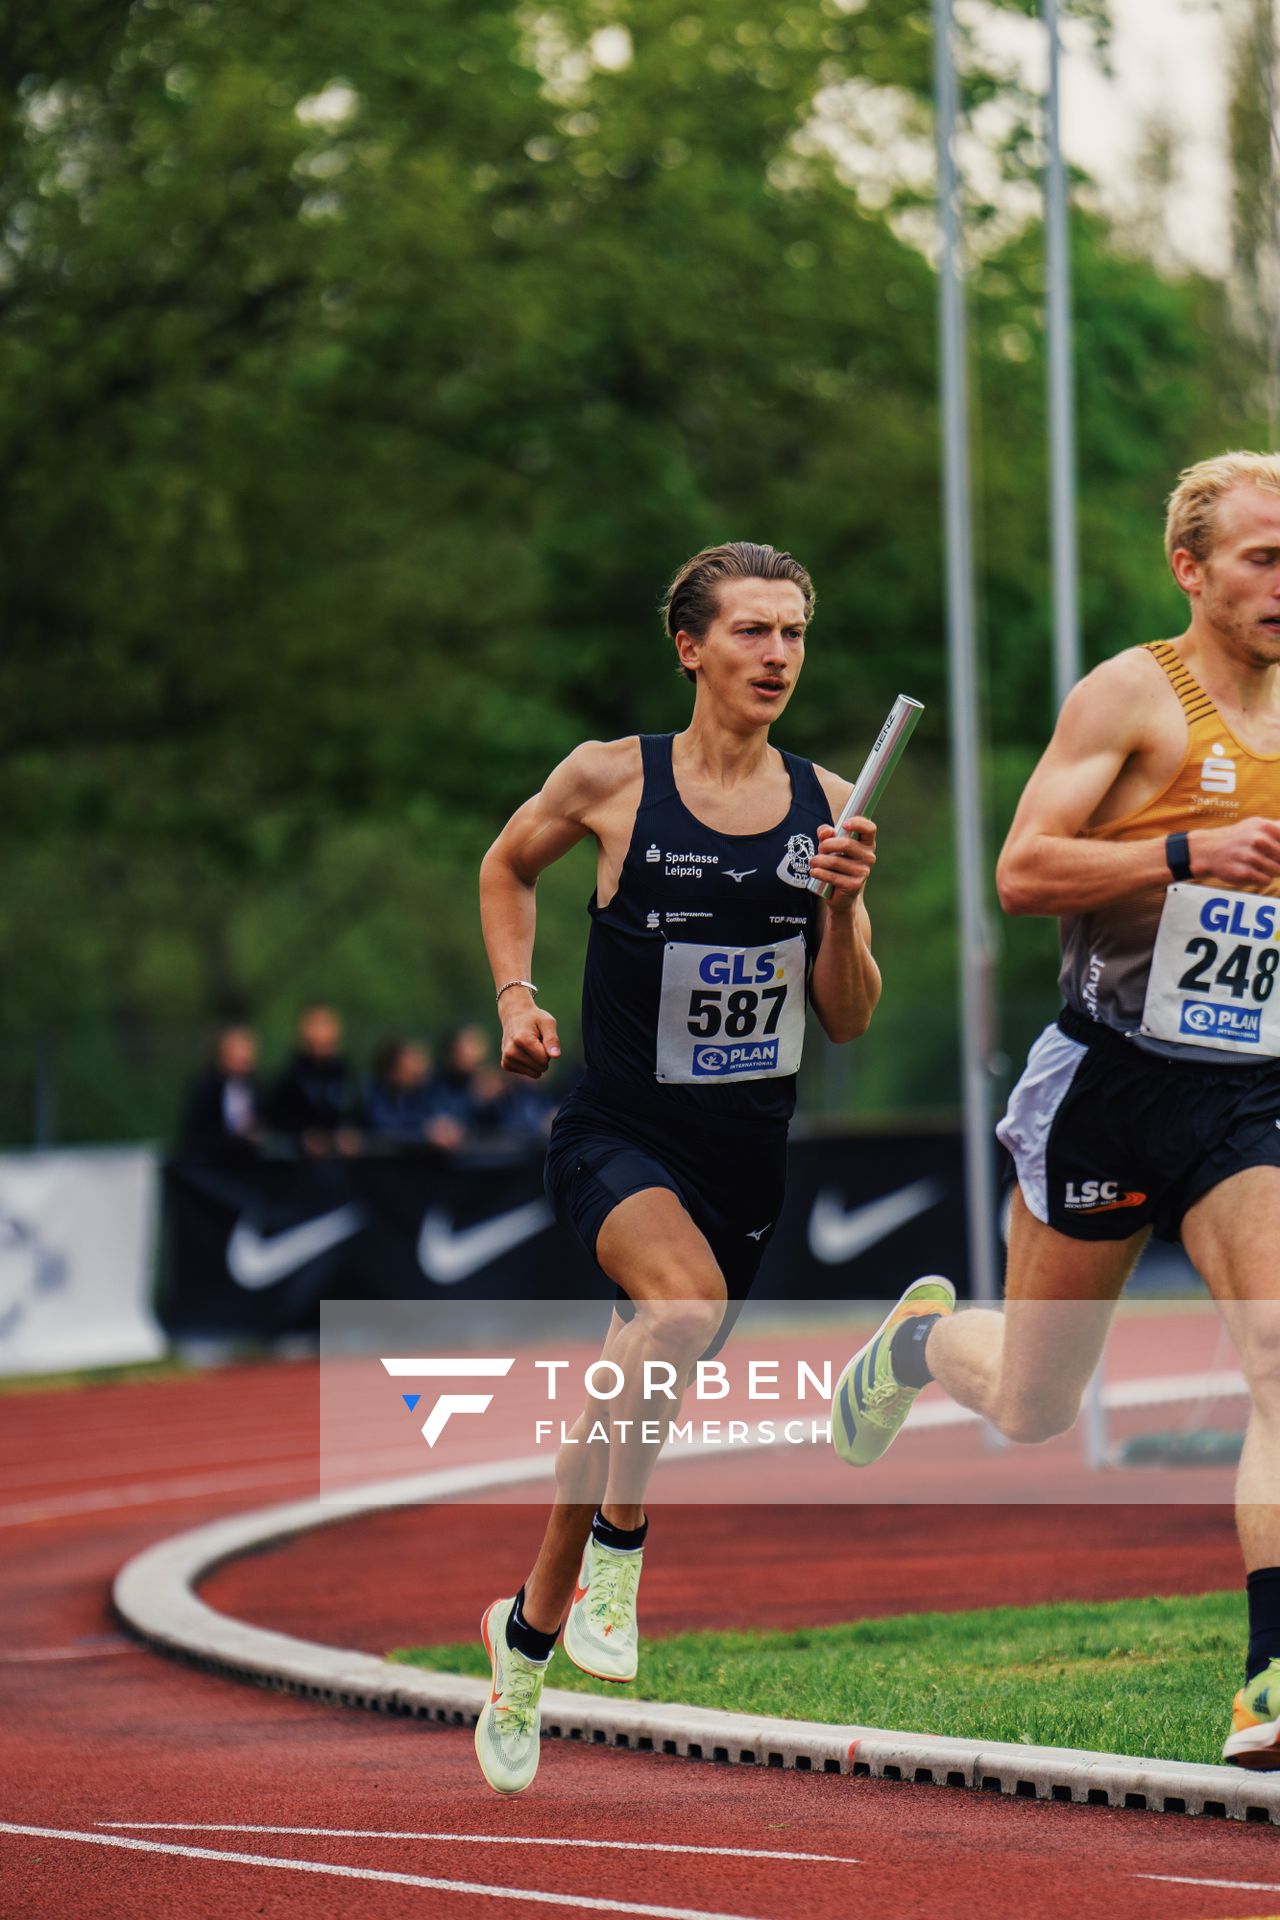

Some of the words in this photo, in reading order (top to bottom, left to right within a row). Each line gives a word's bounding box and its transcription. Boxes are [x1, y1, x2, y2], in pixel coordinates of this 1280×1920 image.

[665, 852, 719, 864] Sparkasse
[665, 865, 702, 878] Leipzig
[1177, 937, 1280, 1003] 248
[687, 984, 788, 1038] 587
[1218, 1010, 1259, 1031] PLAN
[730, 1046, 775, 1063] PLAN
[729, 1061, 774, 1070] INTERNATIONAL
[1065, 1181, 1118, 1203] LSC
